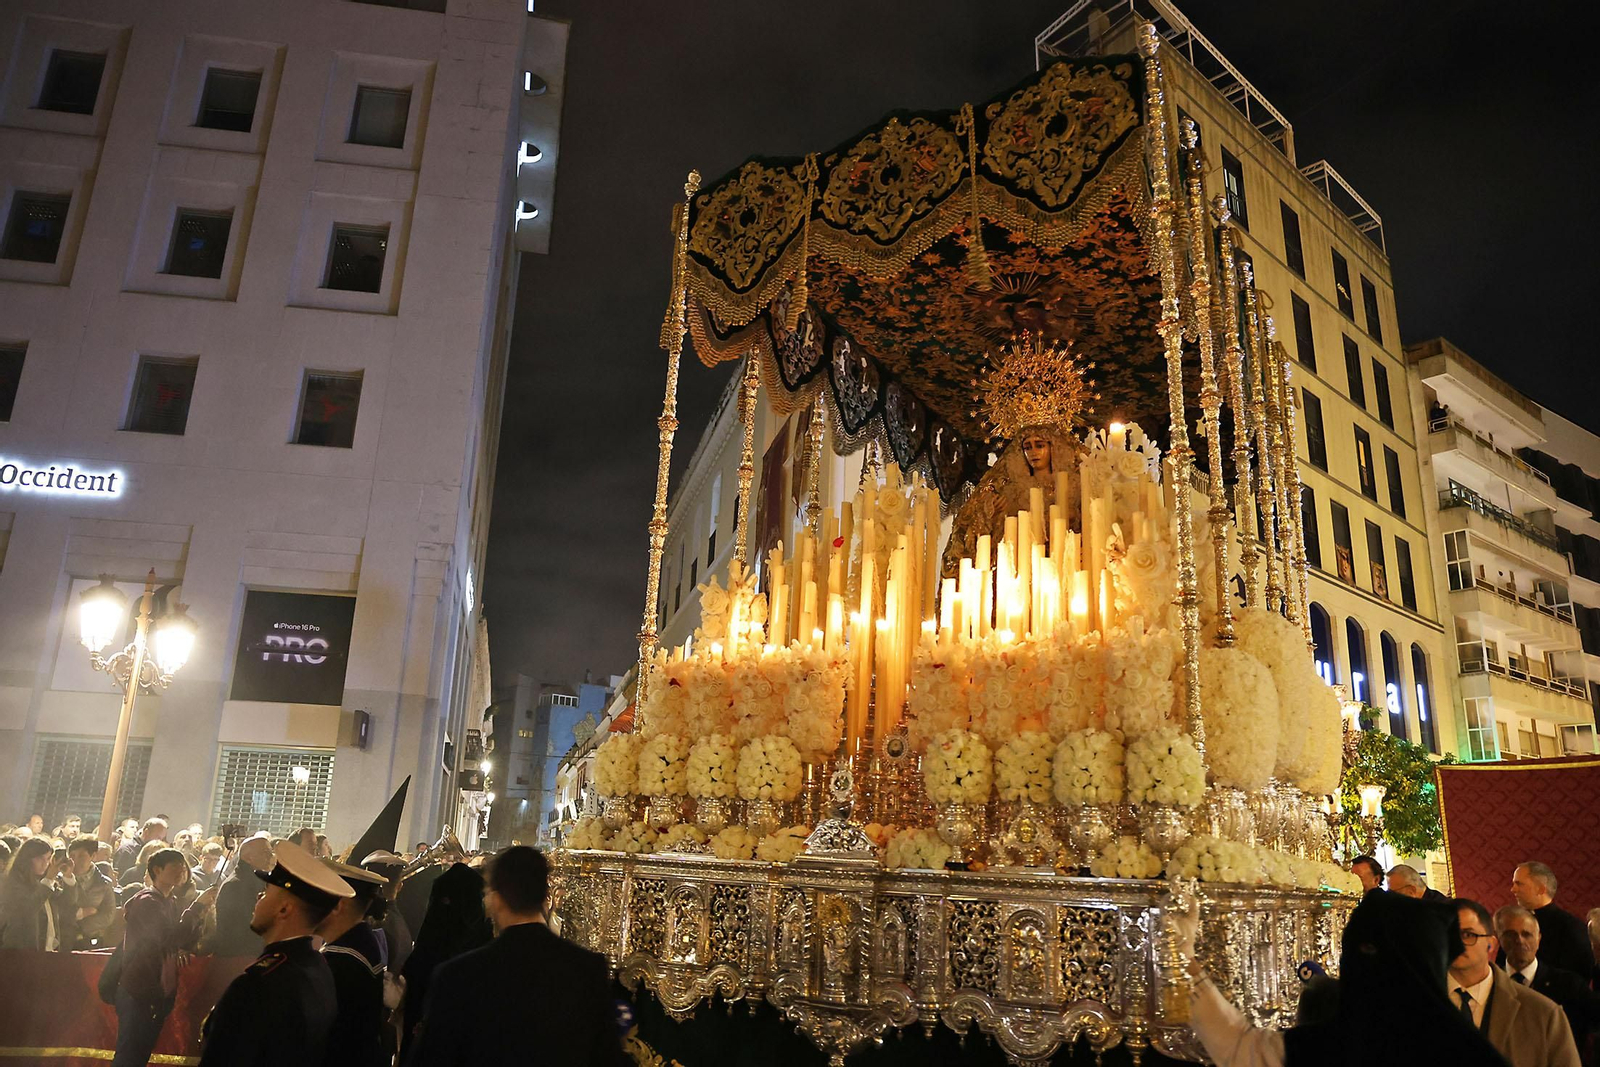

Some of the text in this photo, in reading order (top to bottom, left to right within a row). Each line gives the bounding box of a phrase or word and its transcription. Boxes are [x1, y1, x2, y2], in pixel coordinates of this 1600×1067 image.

[0, 464, 118, 492] Occident
[279, 622, 301, 630] iPhone
[309, 624, 320, 632] Pro
[263, 635, 329, 664] PRO
